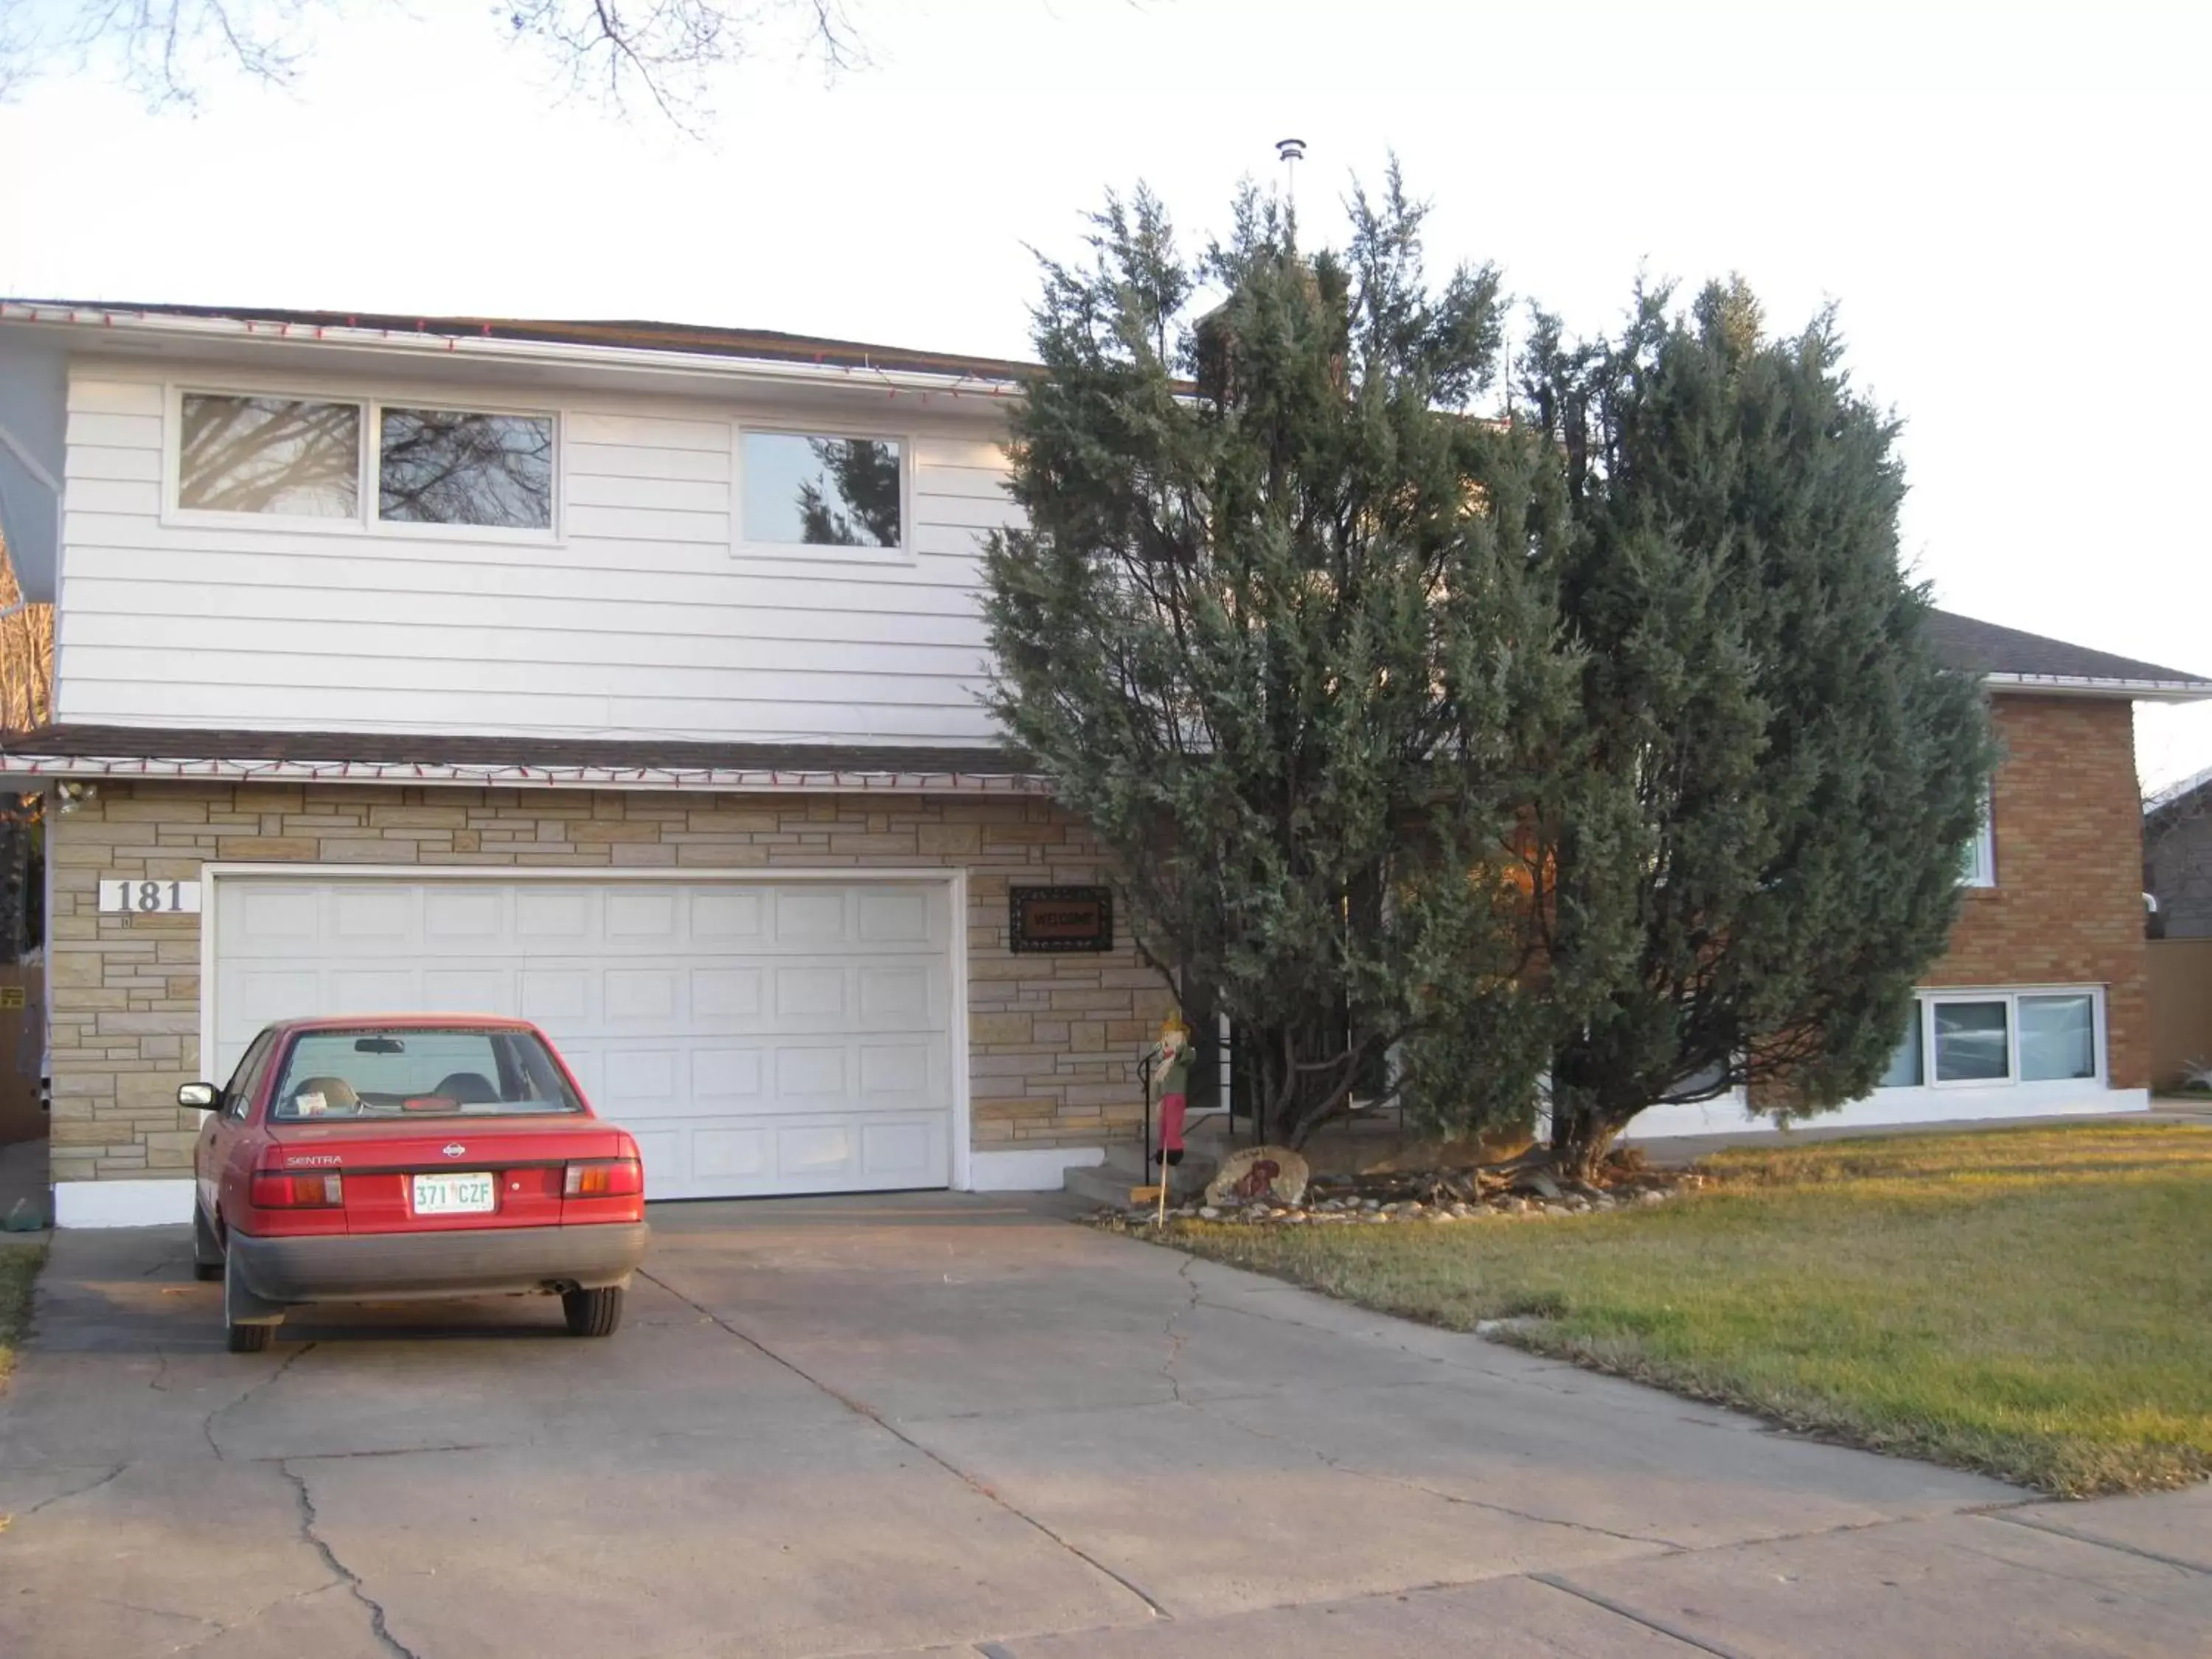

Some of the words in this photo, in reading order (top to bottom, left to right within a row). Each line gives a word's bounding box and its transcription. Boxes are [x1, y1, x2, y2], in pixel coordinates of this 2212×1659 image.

[118, 881, 183, 911] 181
[287, 1155, 343, 1166] SENTRA
[416, 1183, 446, 1206] 371
[459, 1182, 489, 1204] CZF
